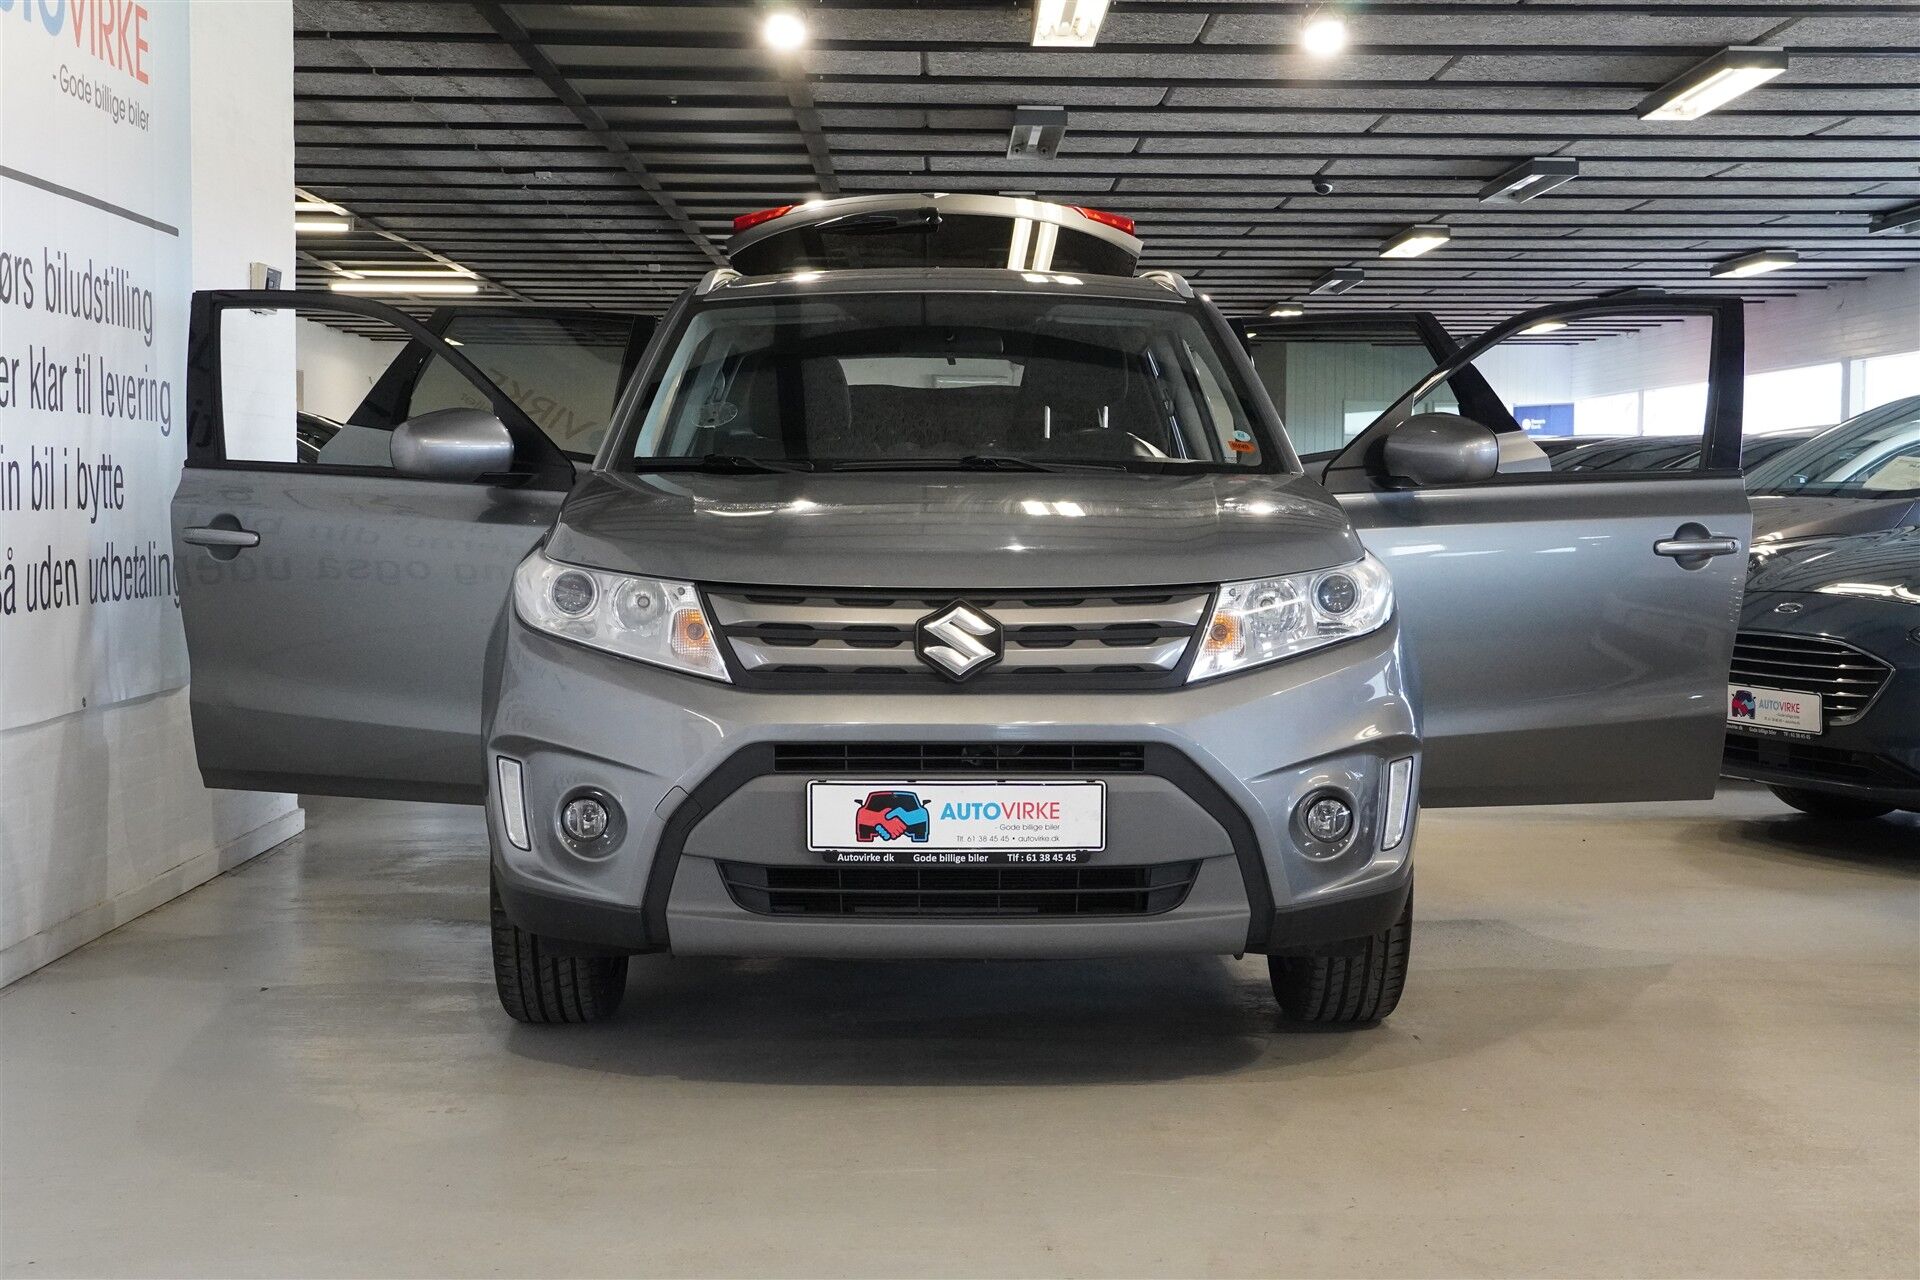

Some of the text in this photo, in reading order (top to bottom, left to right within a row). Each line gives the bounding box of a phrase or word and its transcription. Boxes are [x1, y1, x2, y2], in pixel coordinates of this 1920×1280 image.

[0, 0, 149, 85] VIRKE
[60, 64, 92, 104] Gode
[94, 80, 126, 124] billige
[128, 97, 149, 132] biler
[44, 246, 153, 347] biludstilling
[30, 344, 68, 413] klar
[75, 353, 91, 415] til
[100, 356, 171, 437] levering
[31, 445, 55, 512] bil
[63, 447, 68, 511] i
[77, 447, 125, 523] bytte
[0, 547, 17, 616] å
[26, 544, 80, 612] uden
[1758, 698, 1801, 714] AUTOVIRKE
[940, 801, 1060, 821] AUTOVIRKE
[999, 823, 1021, 831] Gode
[1022, 823, 1043, 832] billige
[1045, 823, 1060, 831] biler
[837, 853, 881, 862] Autovirke
[883, 853, 895, 862] dk
[913, 853, 937, 862] Gode
[939, 853, 966, 864] billige
[968, 853, 989, 862] biler
[1007, 853, 1020, 862] Tlf
[1026, 853, 1037, 862] 61
[1039, 853, 1050, 862] 38
[1052, 853, 1063, 862] 45
[1065, 853, 1077, 862] 45
